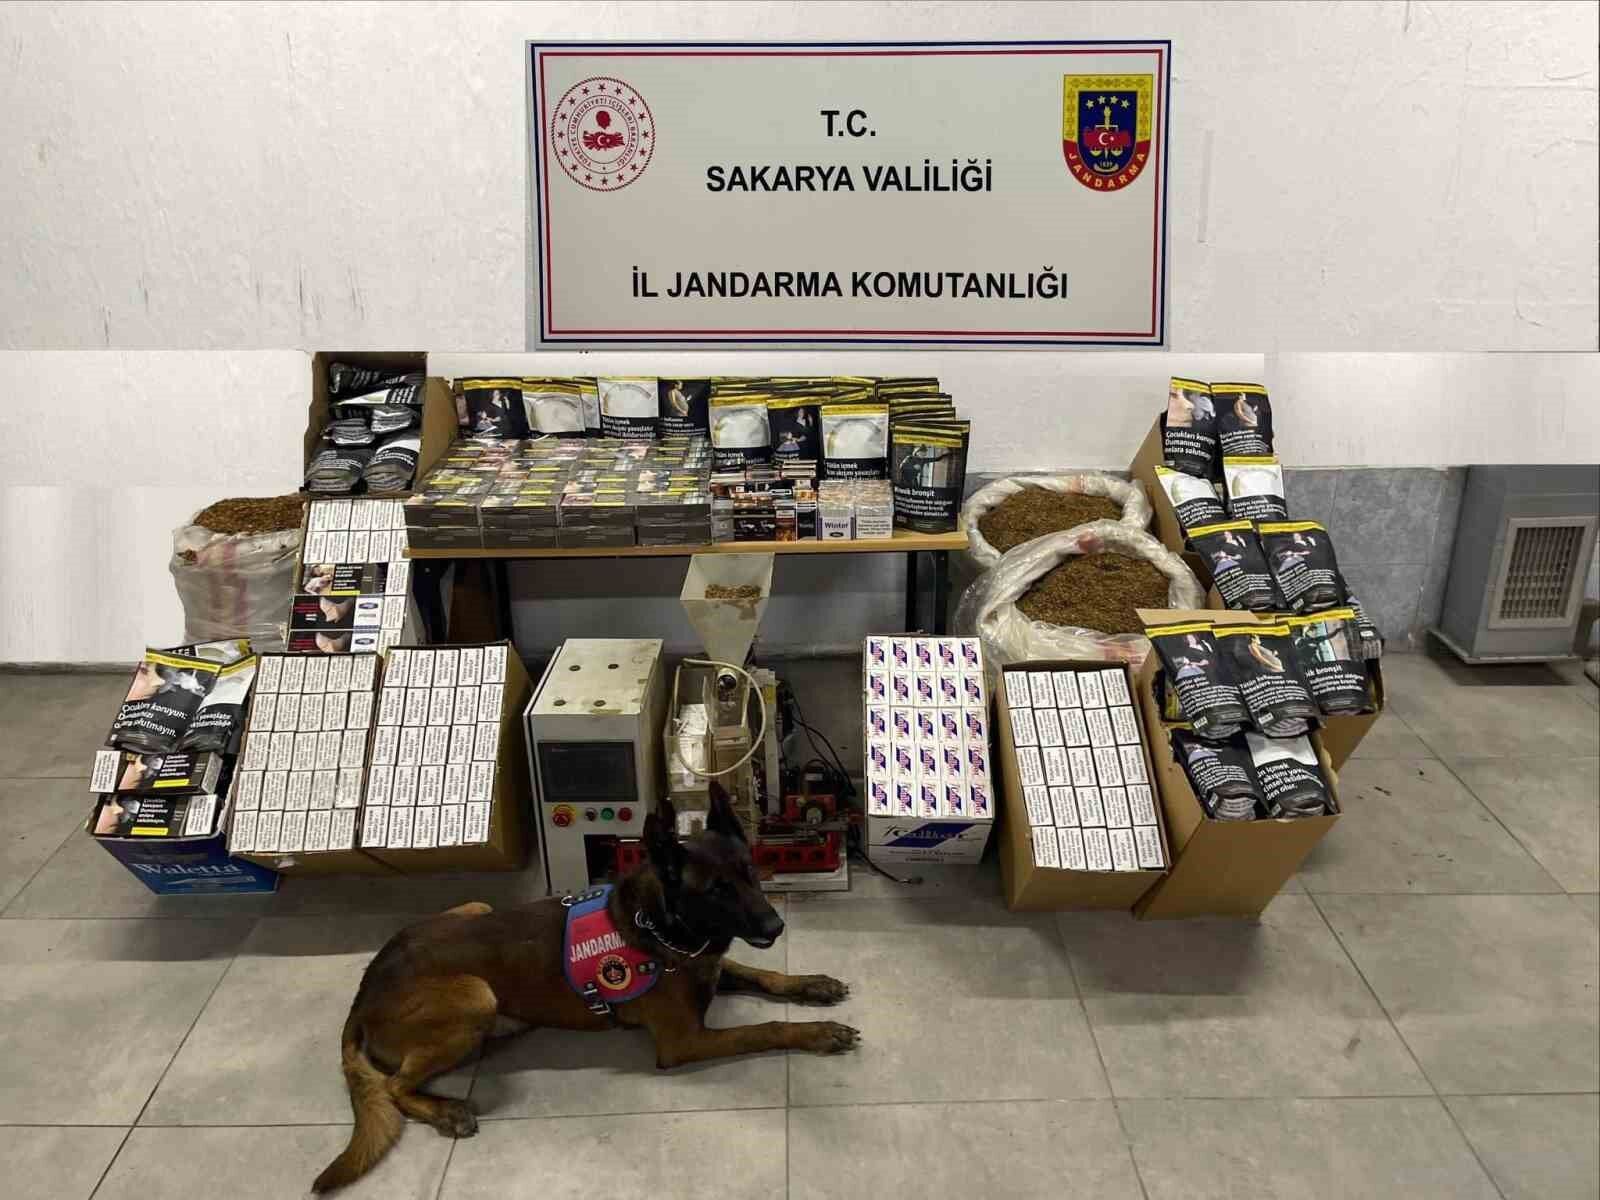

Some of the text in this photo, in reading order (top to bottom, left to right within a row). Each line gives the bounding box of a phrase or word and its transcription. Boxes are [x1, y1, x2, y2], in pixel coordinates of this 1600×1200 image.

[821, 110, 875, 137] T.C.
[707, 159, 991, 191] SAKARYA VALİLİĞİ
[1069, 153, 1145, 188] JANDARMA
[633, 266, 1067, 298] İL JANDARMA KOMUTANLIĞI
[824, 520, 849, 529] Winter
